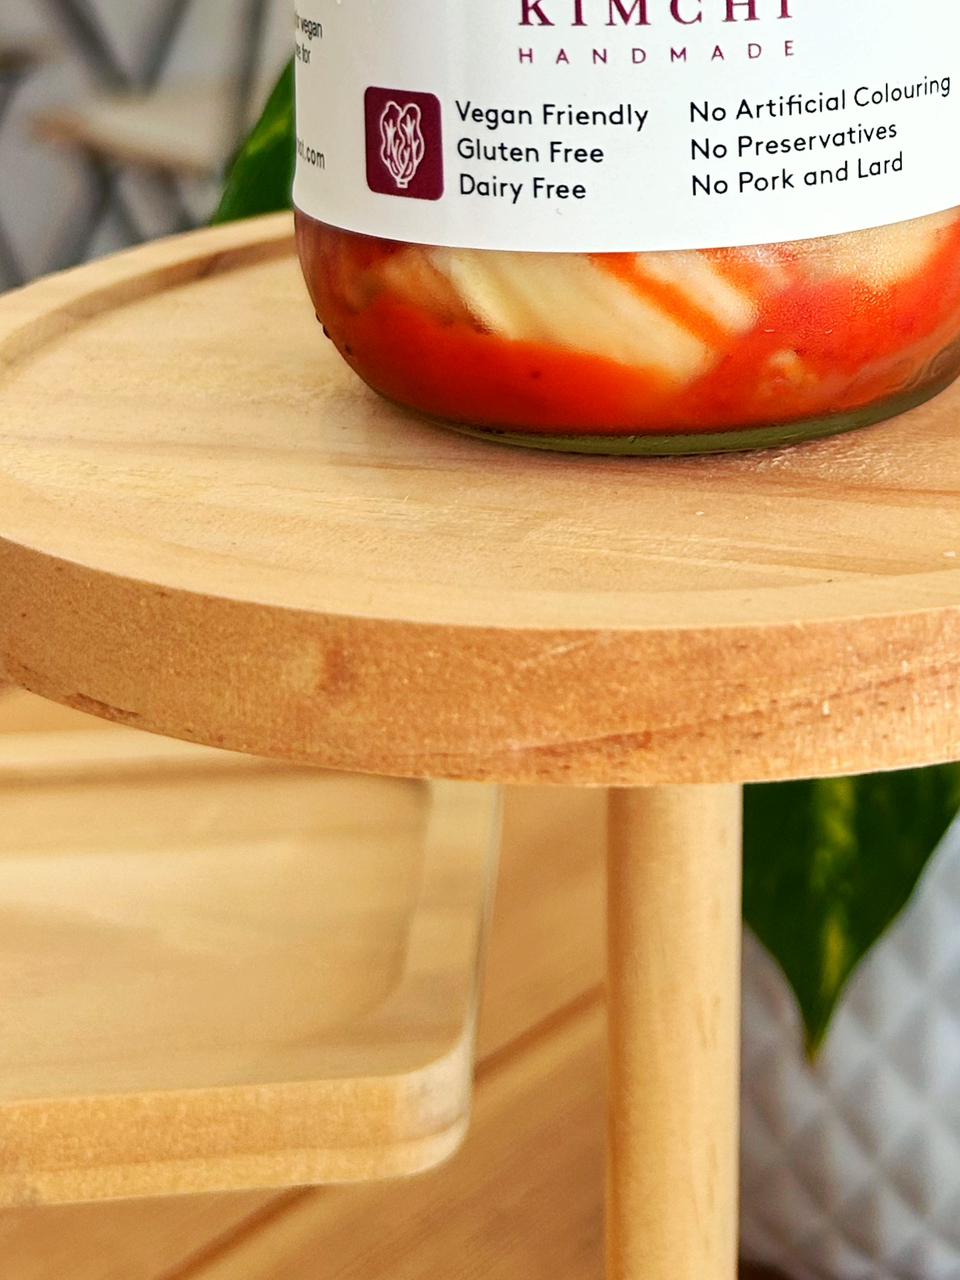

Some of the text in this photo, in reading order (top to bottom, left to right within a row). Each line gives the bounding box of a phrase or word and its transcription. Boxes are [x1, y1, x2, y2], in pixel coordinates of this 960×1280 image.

[518, 40, 795, 64] HANDMADE
[690, 76, 951, 122] No Artificial Colouring
[455, 100, 649, 132] Vegan Friendly
[457, 138, 605, 163] Gluten Free
[691, 123, 898, 160] No Preservatives
[459, 174, 587, 204] Dairy Free
[692, 151, 903, 196] No Pork and Lard
